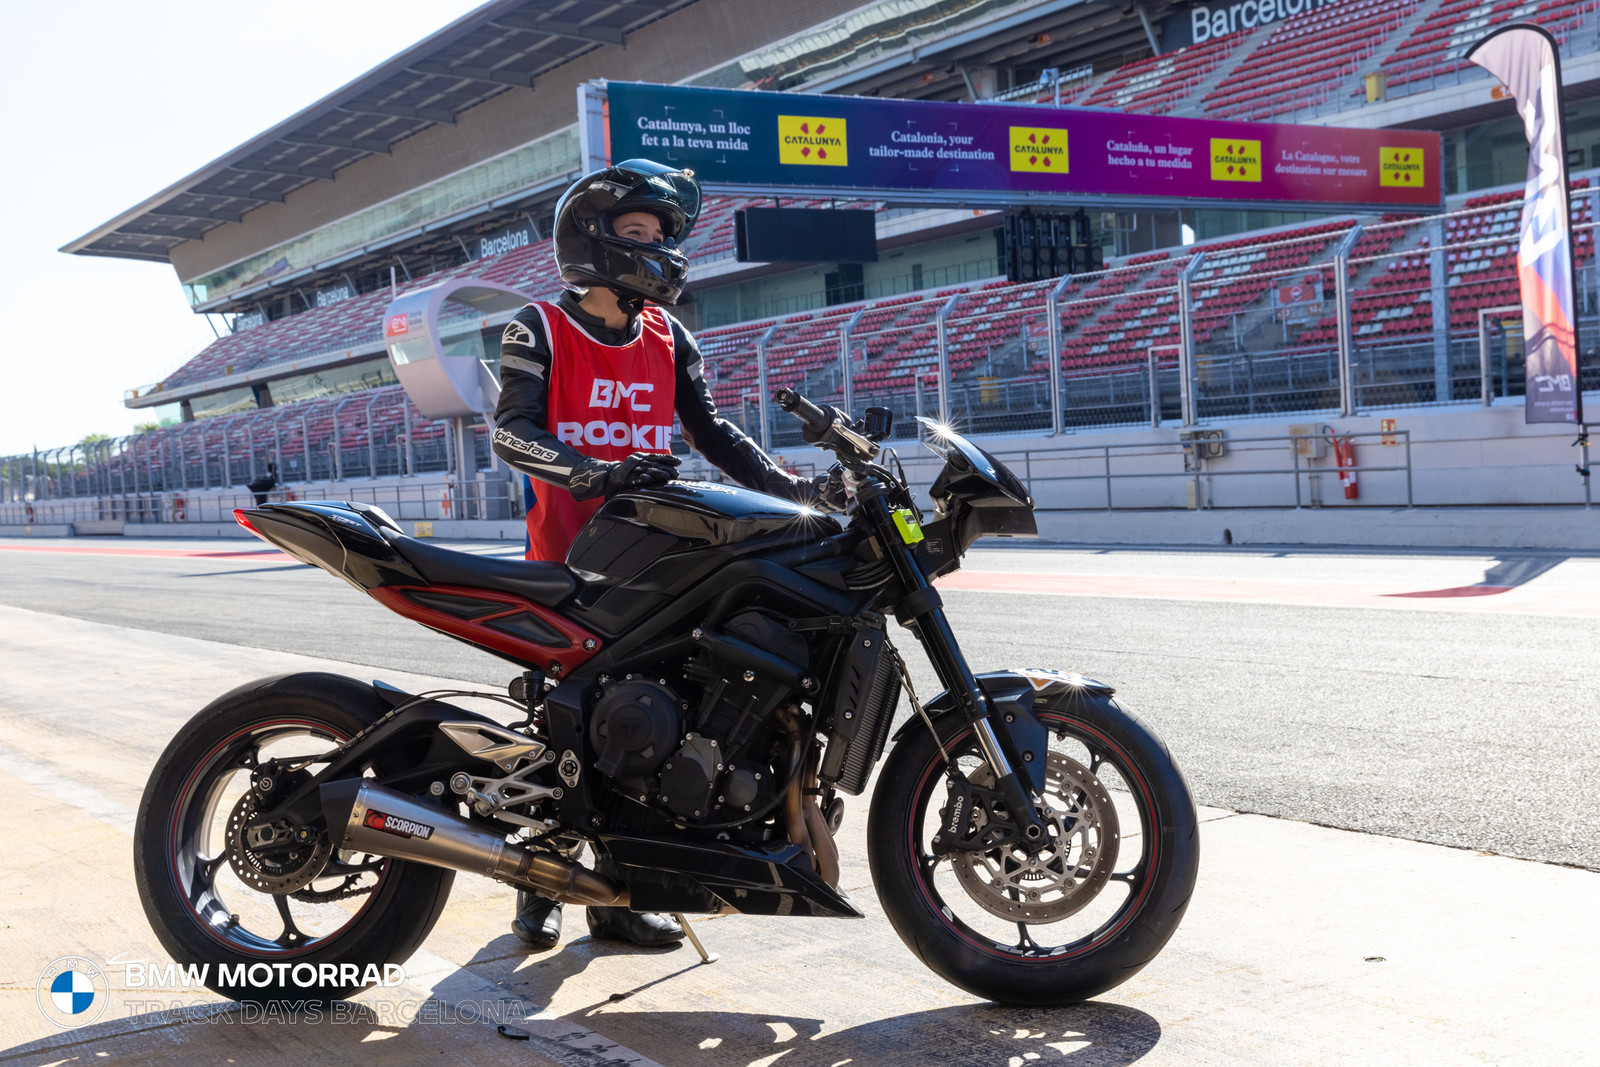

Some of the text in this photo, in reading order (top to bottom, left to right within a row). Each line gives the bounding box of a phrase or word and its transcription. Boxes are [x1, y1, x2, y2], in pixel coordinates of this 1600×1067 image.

[637, 116, 751, 135] Catalunya, un lloc
[641, 133, 749, 150] fet a la teva mida
[784, 135, 841, 146] CATALUNYA
[891, 130, 974, 146] Catalonia, your
[869, 145, 995, 160] tailor-made destination
[1014, 145, 1064, 155] CATALUNYA
[1106, 139, 1193, 157] Cataluña, un lugar
[1282, 150, 1294, 161] La
[1108, 153, 1193, 169] hecho a tu medida
[1214, 155, 1257, 165] CATALUNYA
[480, 229, 529, 258] Barcelona
[589, 378, 654, 412] BMC
[557, 420, 673, 450] ROOKIE
[948, 795, 964, 834] brembo
[384, 815, 431, 838] SCORPION
